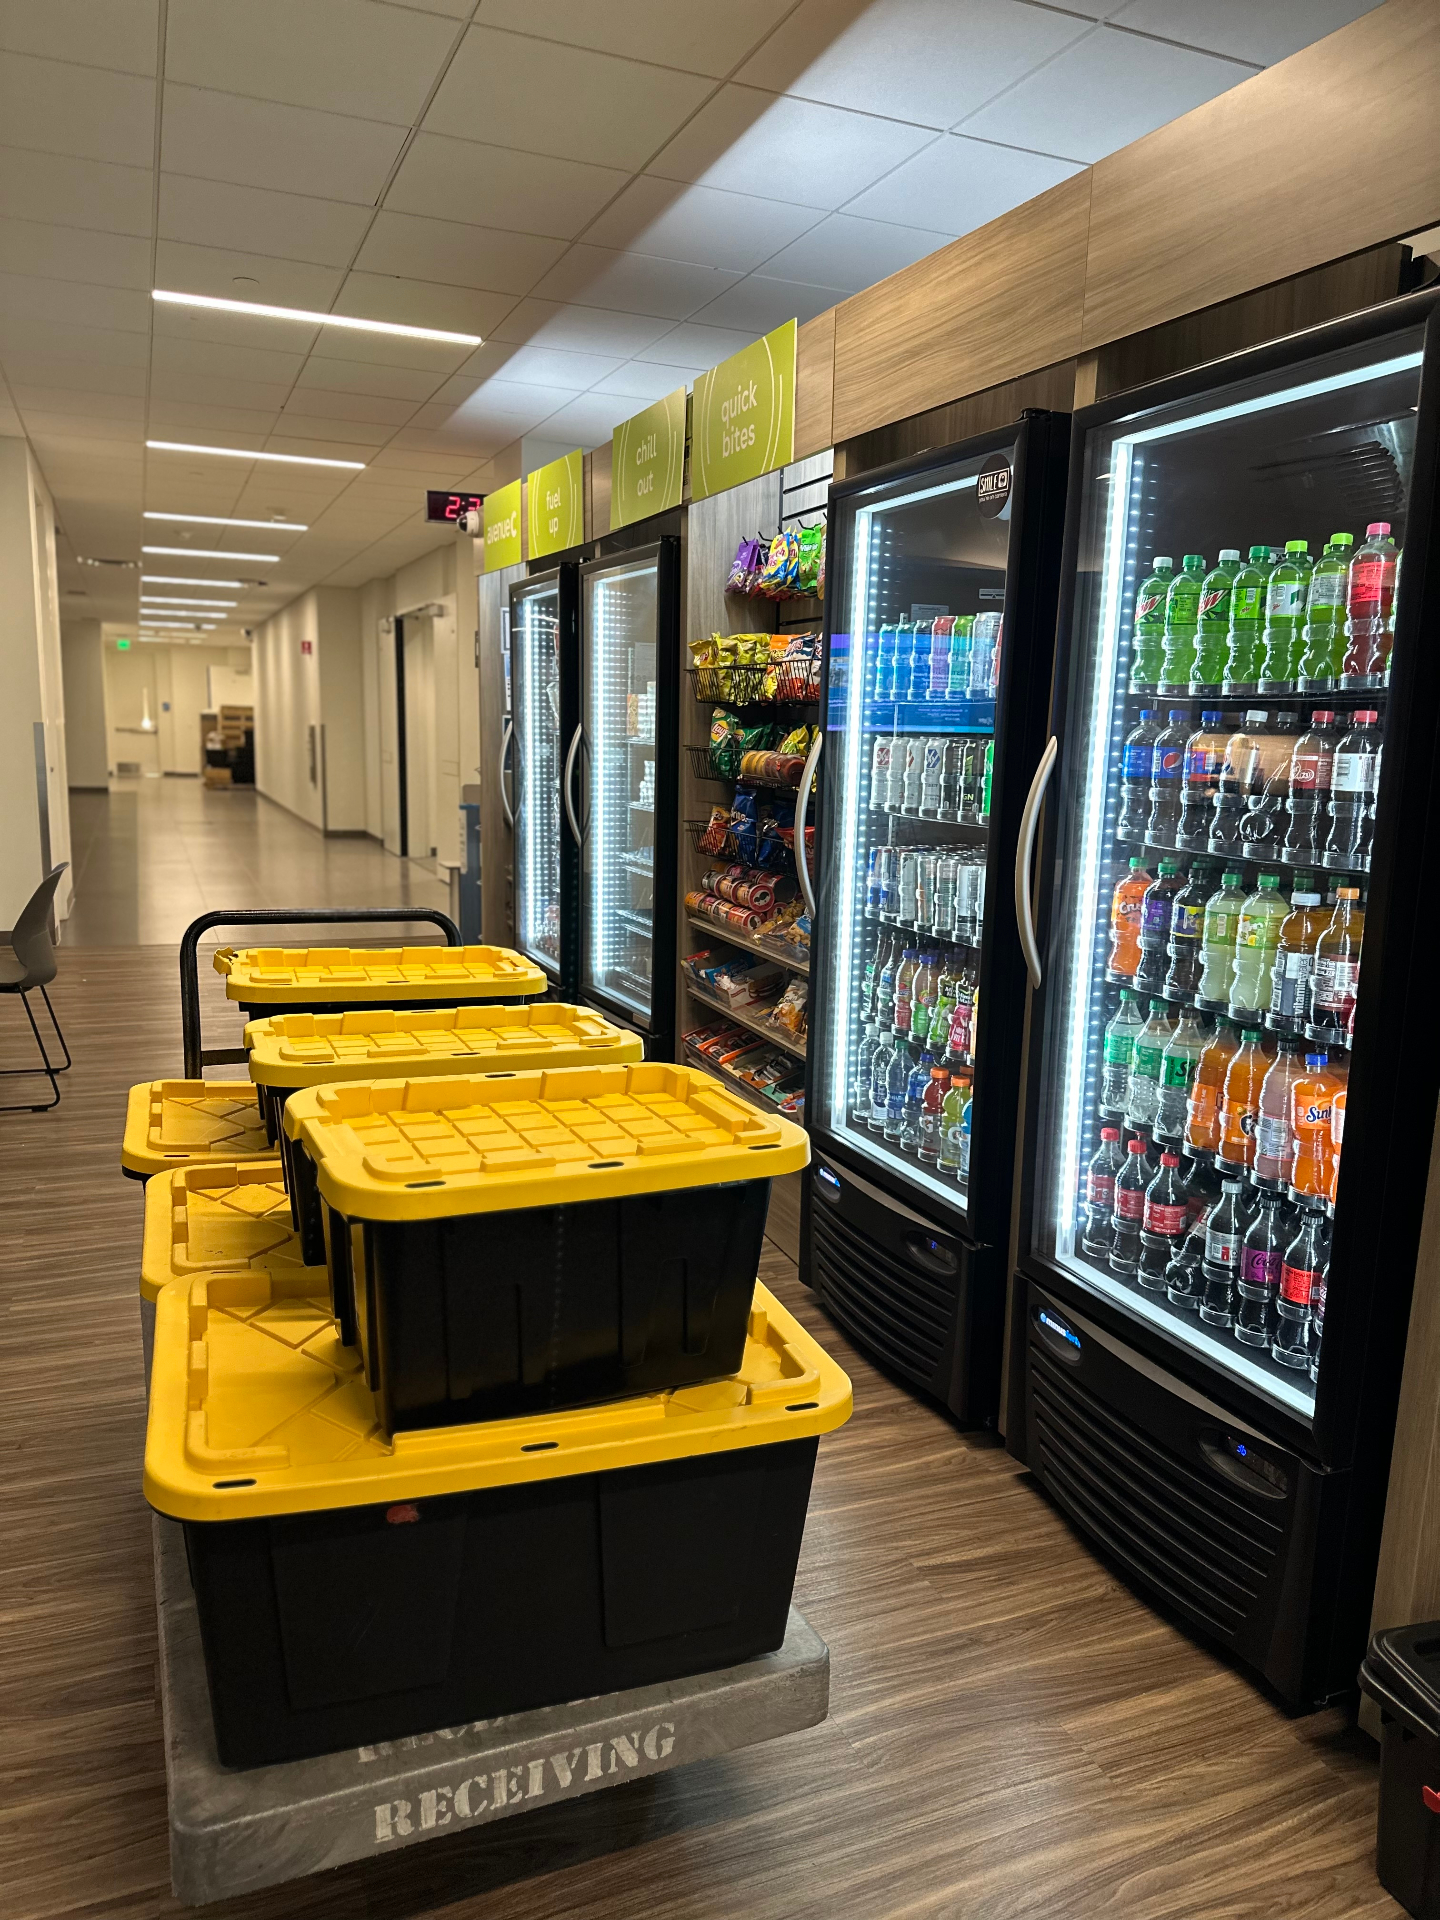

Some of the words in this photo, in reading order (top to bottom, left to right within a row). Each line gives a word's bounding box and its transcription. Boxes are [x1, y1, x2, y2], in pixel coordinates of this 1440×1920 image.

[721, 380, 758, 429] quick
[636, 433, 657, 466] chill
[722, 424, 756, 458] bites
[546, 487, 562, 511] fuel
[637, 470, 654, 497] out
[486, 510, 518, 545] avenueC
[548, 519, 559, 539] up
[373, 1721, 676, 1844] RECEIVING
